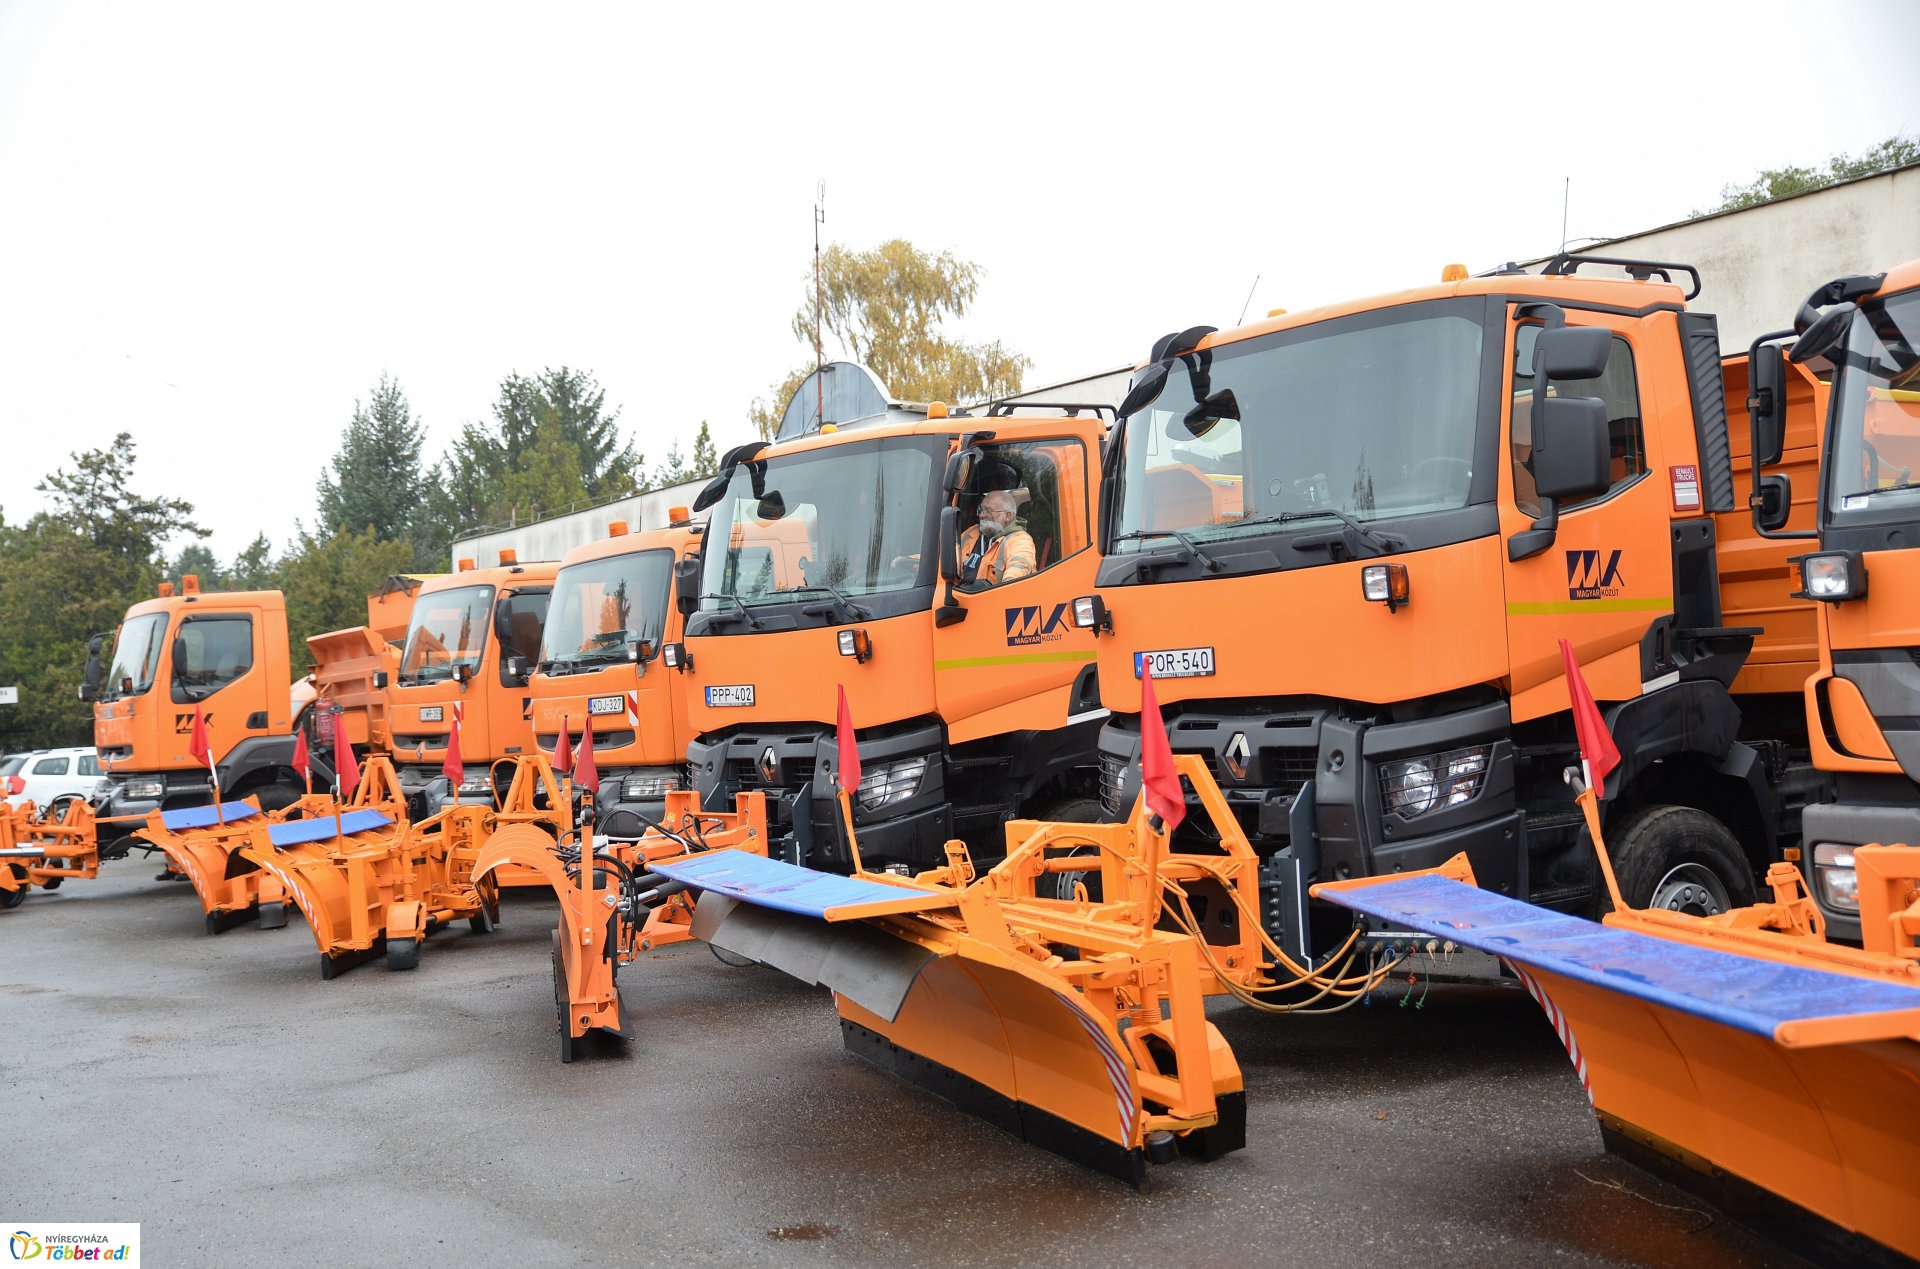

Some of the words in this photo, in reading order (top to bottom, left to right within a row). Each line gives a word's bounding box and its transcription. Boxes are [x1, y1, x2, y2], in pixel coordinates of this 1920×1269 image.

[1576, 589, 1600, 598] MAGYAR
[1014, 636, 1040, 645] MAGYAR
[712, 687, 752, 702] PPP-402
[593, 698, 622, 711] KDJ-327
